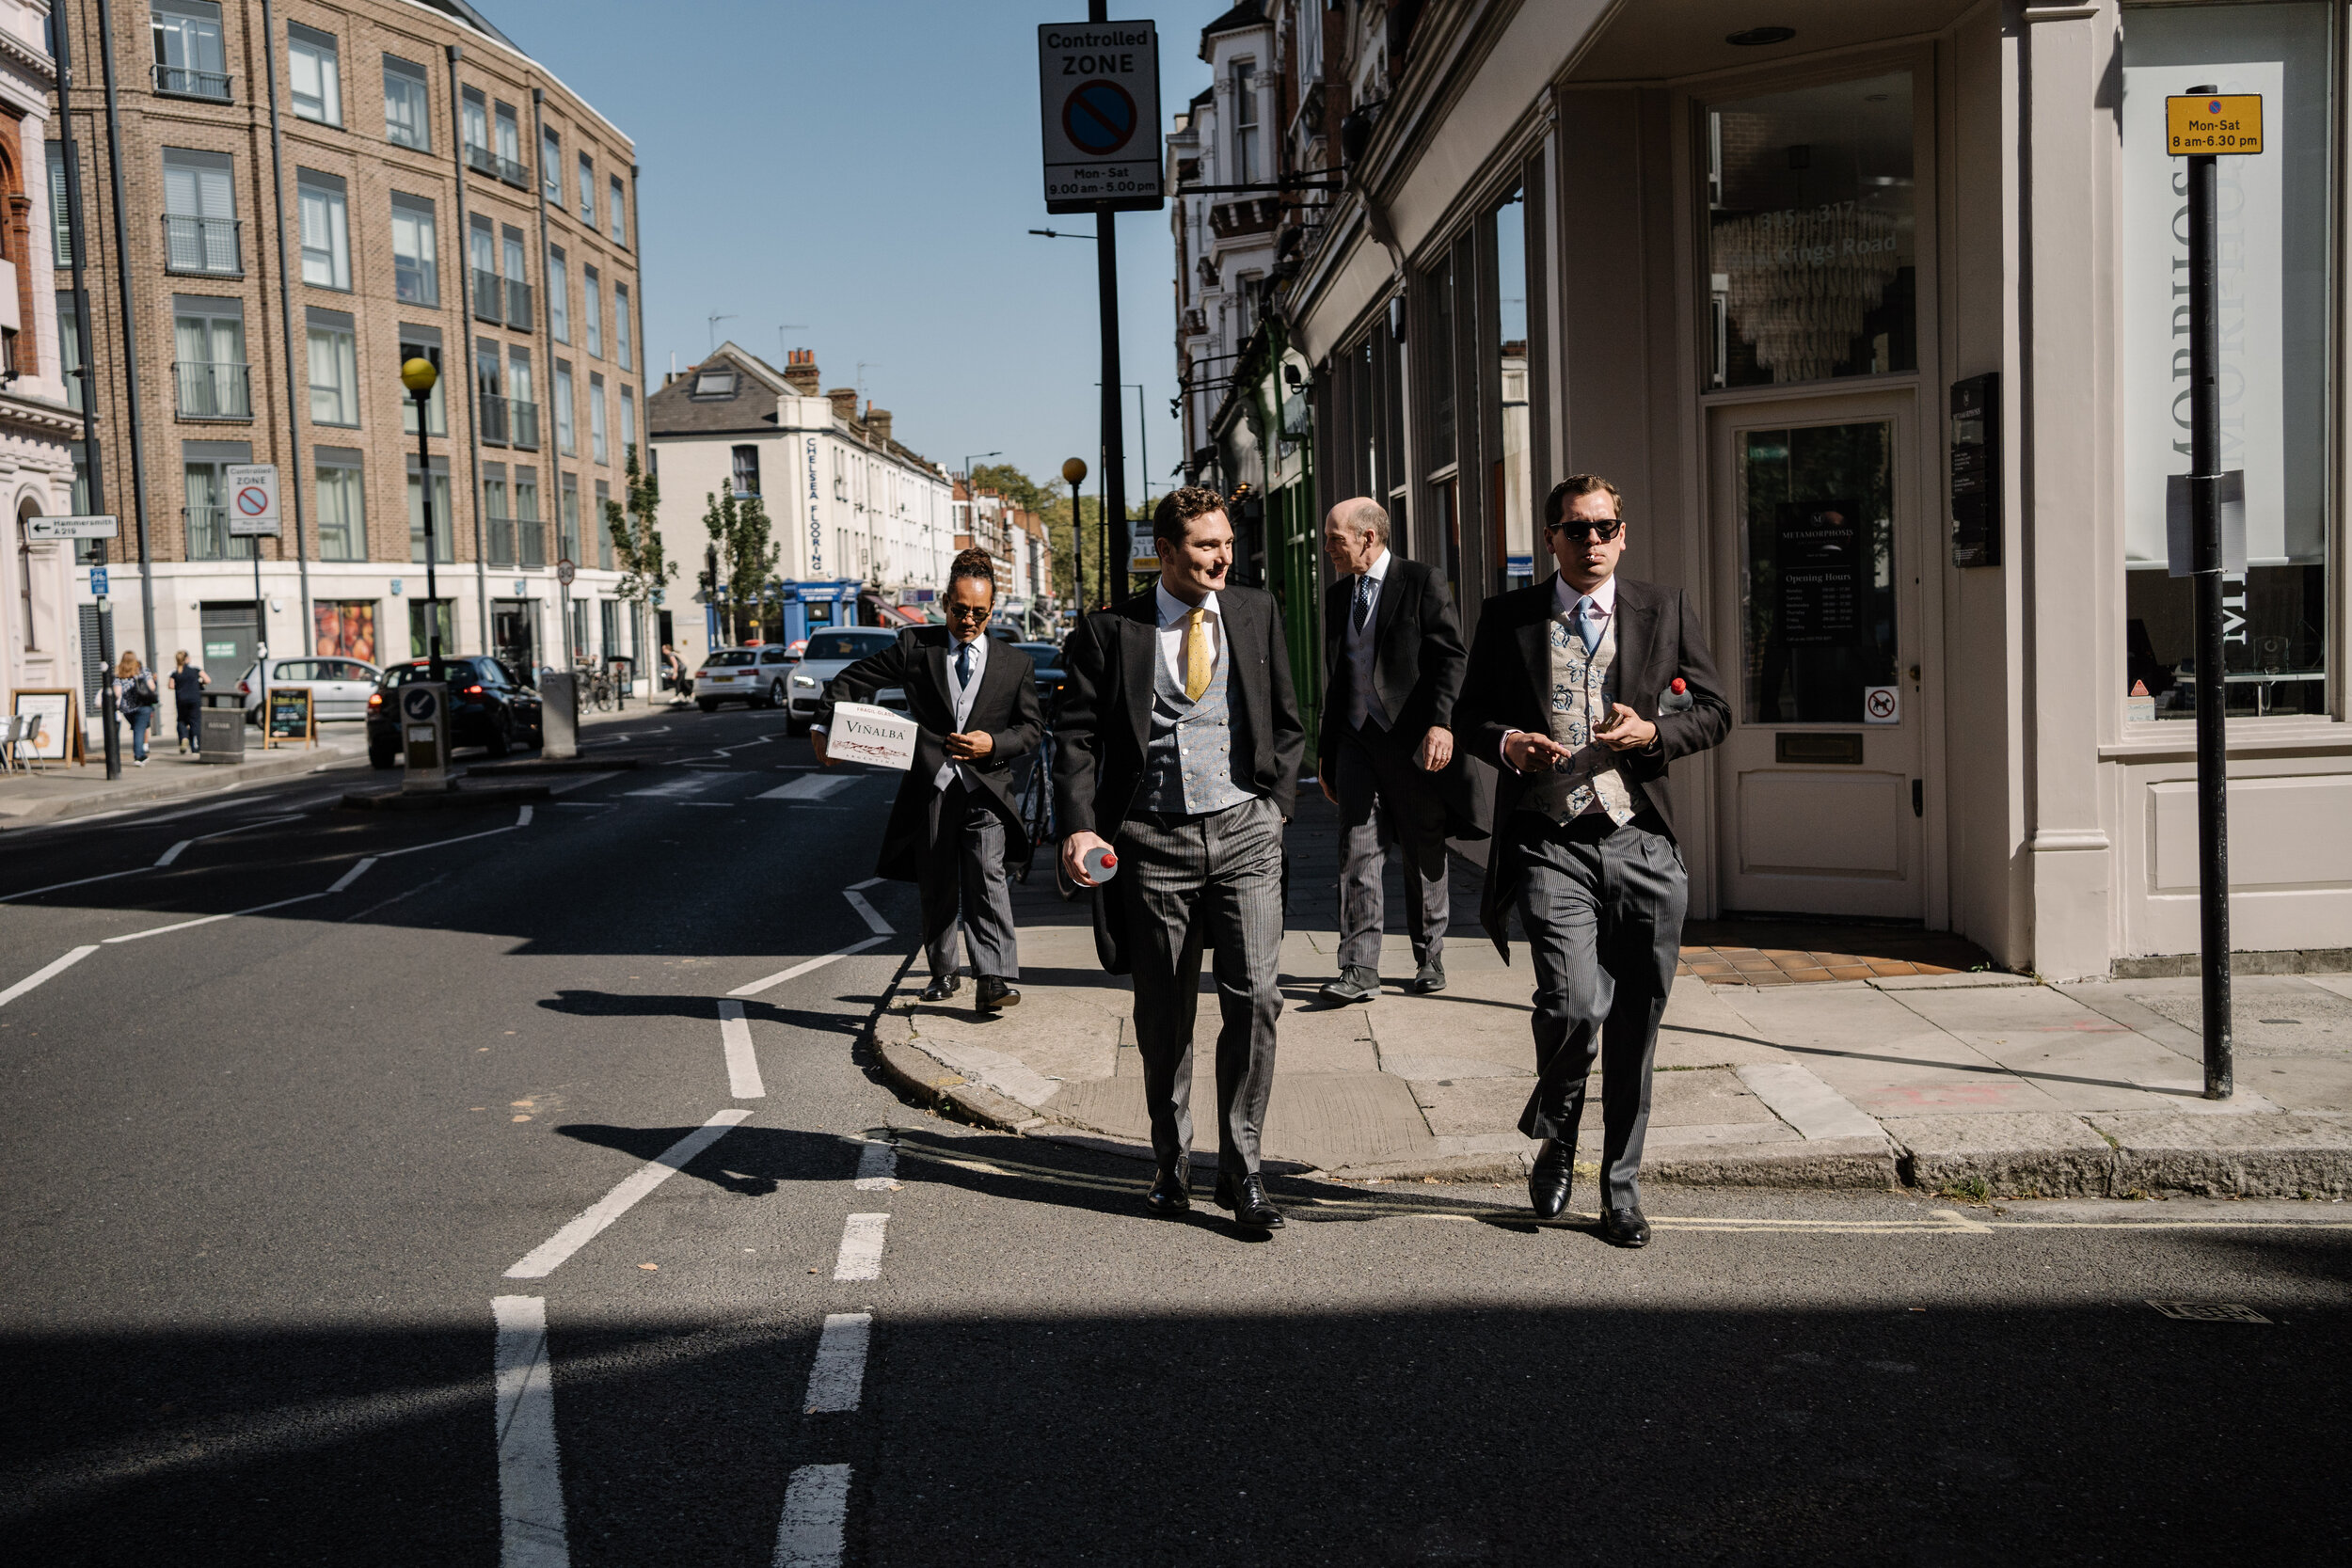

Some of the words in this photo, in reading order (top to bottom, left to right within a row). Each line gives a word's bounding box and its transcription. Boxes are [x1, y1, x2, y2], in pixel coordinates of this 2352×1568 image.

[1047, 30, 1148, 49] Controlled
[1062, 54, 1135, 75] ZONE
[2189, 119, 2240, 131] Mon-Sat
[2172, 136, 2181, 147] 8
[2239, 137, 2258, 148] pm
[1074, 168, 1100, 180] Mon
[1108, 167, 1130, 177] Sat
[1049, 184, 1079, 196] 9.00
[1080, 185, 1099, 194] am
[1106, 182, 1136, 193] 5.00
[1137, 182, 1156, 192] pm
[1818, 199, 1855, 223] 317
[1778, 242, 1836, 265] Kings
[1842, 232, 1897, 257] Road
[806, 437, 818, 499] CHELSEA
[236, 476, 267, 484] ZONE
[810, 505, 821, 570] FLOORING
[1782, 529, 1853, 539] METAMORPHOSIS
[1786, 576, 1823, 584] Opening
[1825, 573, 1851, 581] Hours
[847, 721, 904, 740] VIÑALBA
